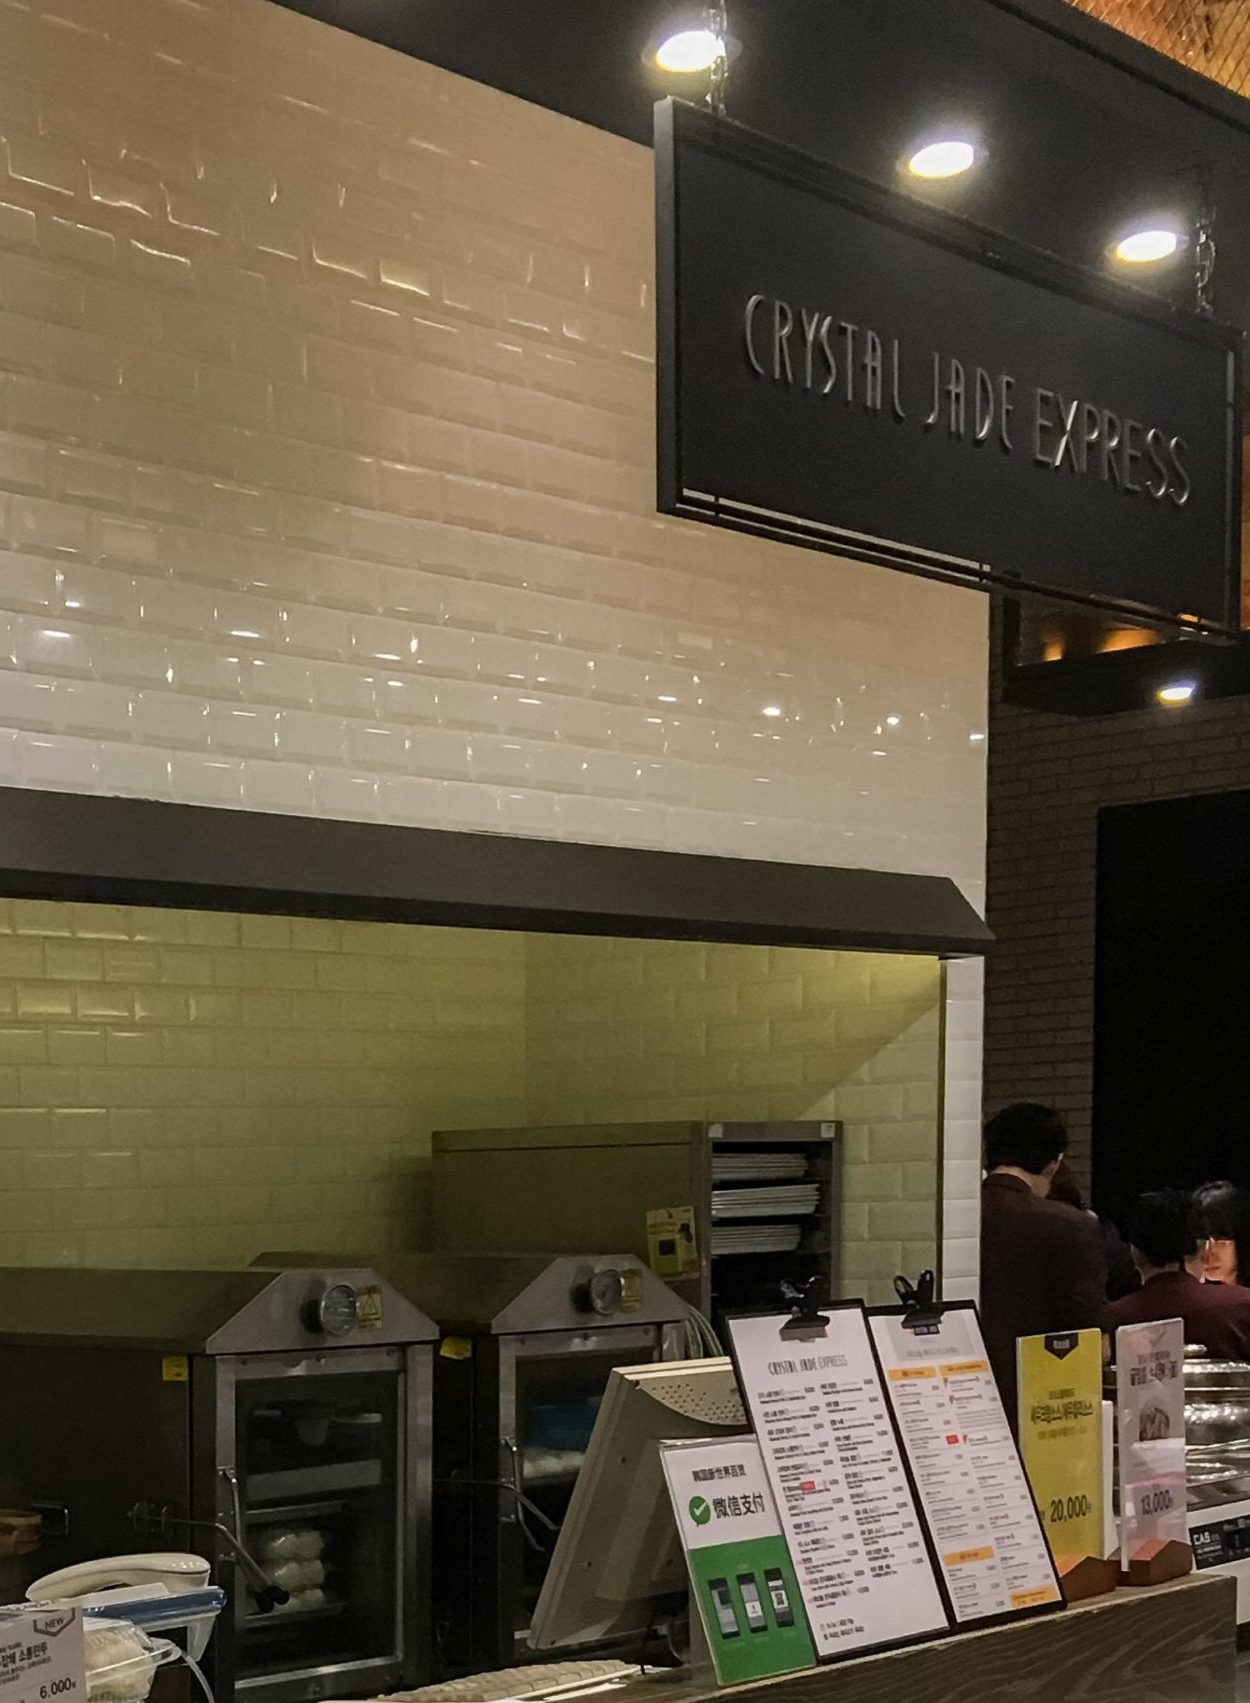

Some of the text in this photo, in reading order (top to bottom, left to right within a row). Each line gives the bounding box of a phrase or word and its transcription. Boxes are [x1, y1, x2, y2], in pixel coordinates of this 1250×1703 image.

[744, 294, 1191, 507] CRYSTAL JADE EXPRESS
[713, 1491, 765, 1520] 微信支付
[45, 1617, 65, 1630] NEW
